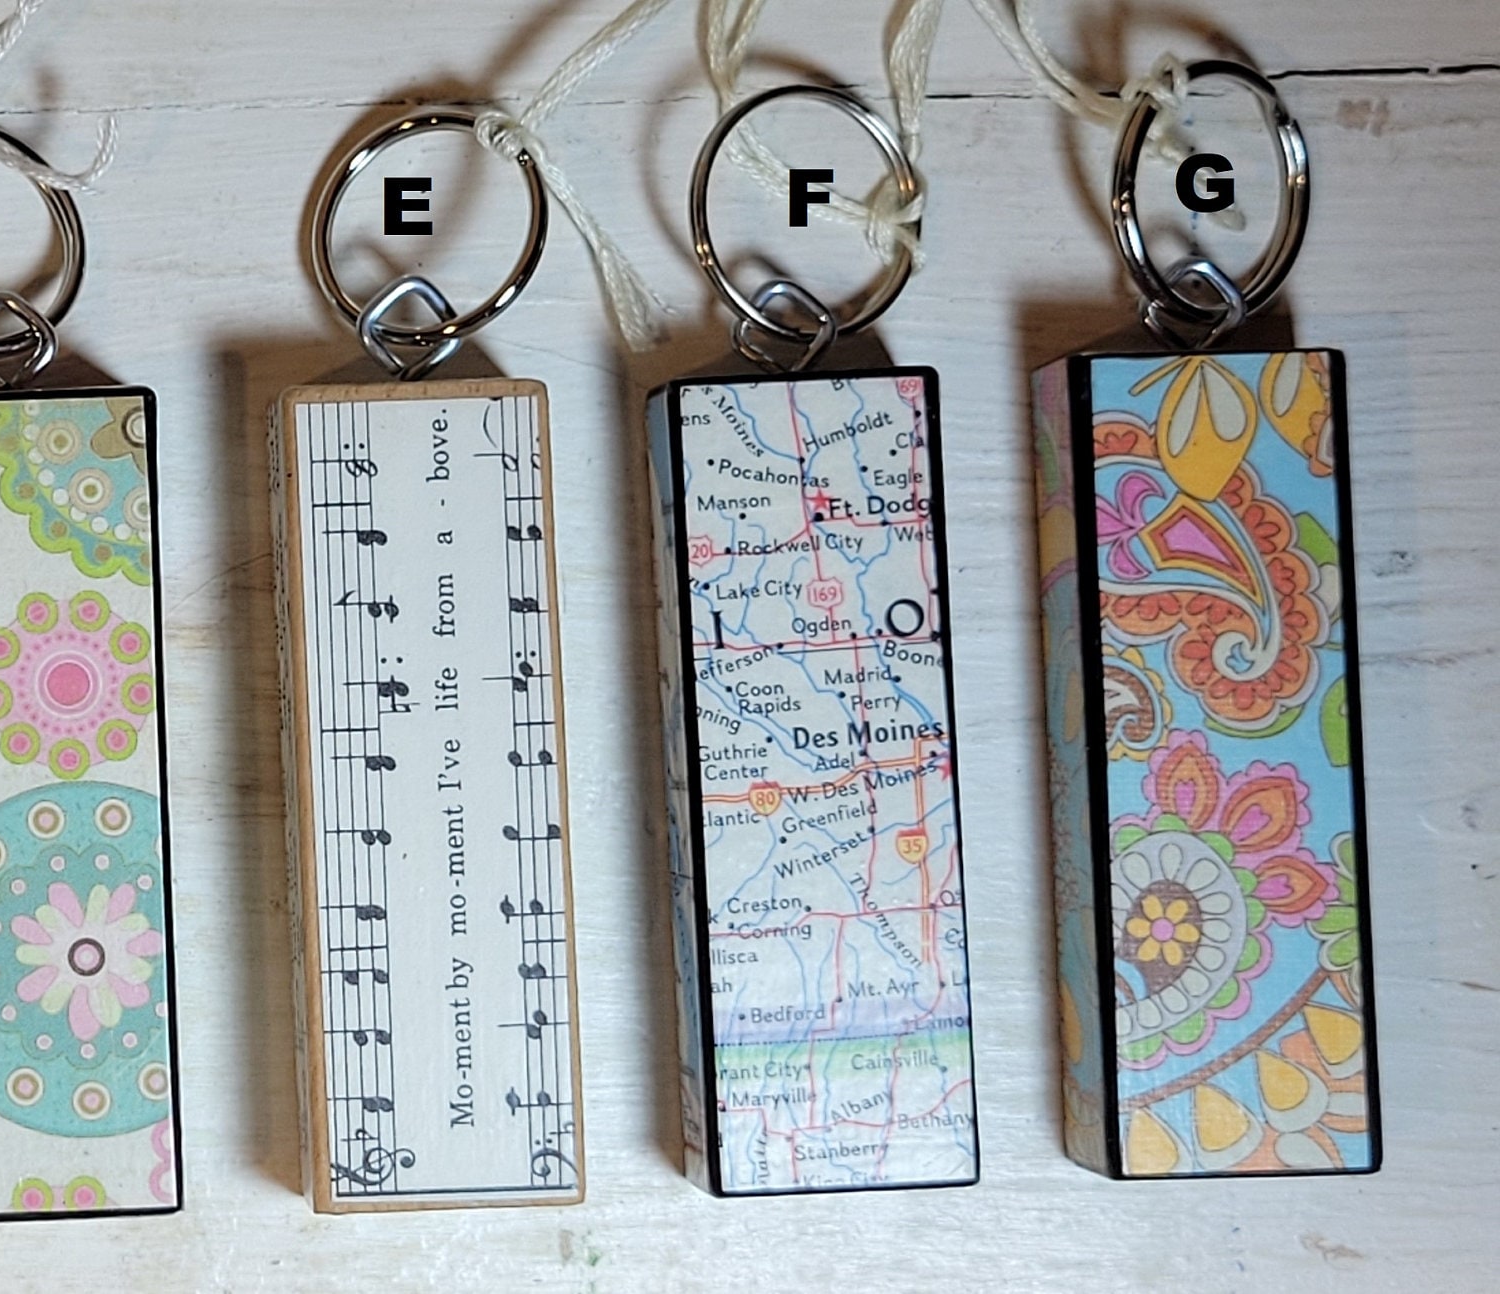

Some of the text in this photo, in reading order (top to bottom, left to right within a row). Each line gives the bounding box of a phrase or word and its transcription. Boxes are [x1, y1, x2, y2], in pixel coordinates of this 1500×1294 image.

[804, 413, 893, 452] Humboldt
[718, 459, 830, 487] Pocahontas
[874, 469, 923, 489] Eagle
[698, 495, 771, 511] Manson
[829, 498, 860, 518] Ft.
[692, 543, 709, 558] 20
[738, 533, 863, 555] Rockwell City
[716, 579, 803, 599] Lake City
[434, 573, 455, 637] from
[792, 617, 851, 633] Ogden
[824, 666, 891, 684] Madrid
[436, 666, 459, 711] life
[736, 681, 784, 697] Coon
[738, 698, 801, 717] Rapids
[851, 694, 901, 712] Perry
[793, 720, 944, 749] Des Moines
[438, 738, 460, 790] I've
[815, 752, 855, 770] Adel
[705, 765, 769, 781] Center
[823, 782, 859, 798] Des
[863, 761, 938, 794] Moines
[756, 790, 775, 806] 80
[782, 800, 878, 830] Greenfield
[774, 830, 866, 879] Winterset
[902, 840, 922, 854] 35
[728, 896, 802, 914] Creston
[737, 921, 812, 939] Corning
[445, 957, 474, 992] by
[848, 979, 920, 1002] Mt. Ayr
[752, 1004, 826, 1023] Bedford
[765, 1059, 802, 1080] City
[851, 1049, 939, 1071] Cainsville
[831, 1090, 893, 1125] Albany
